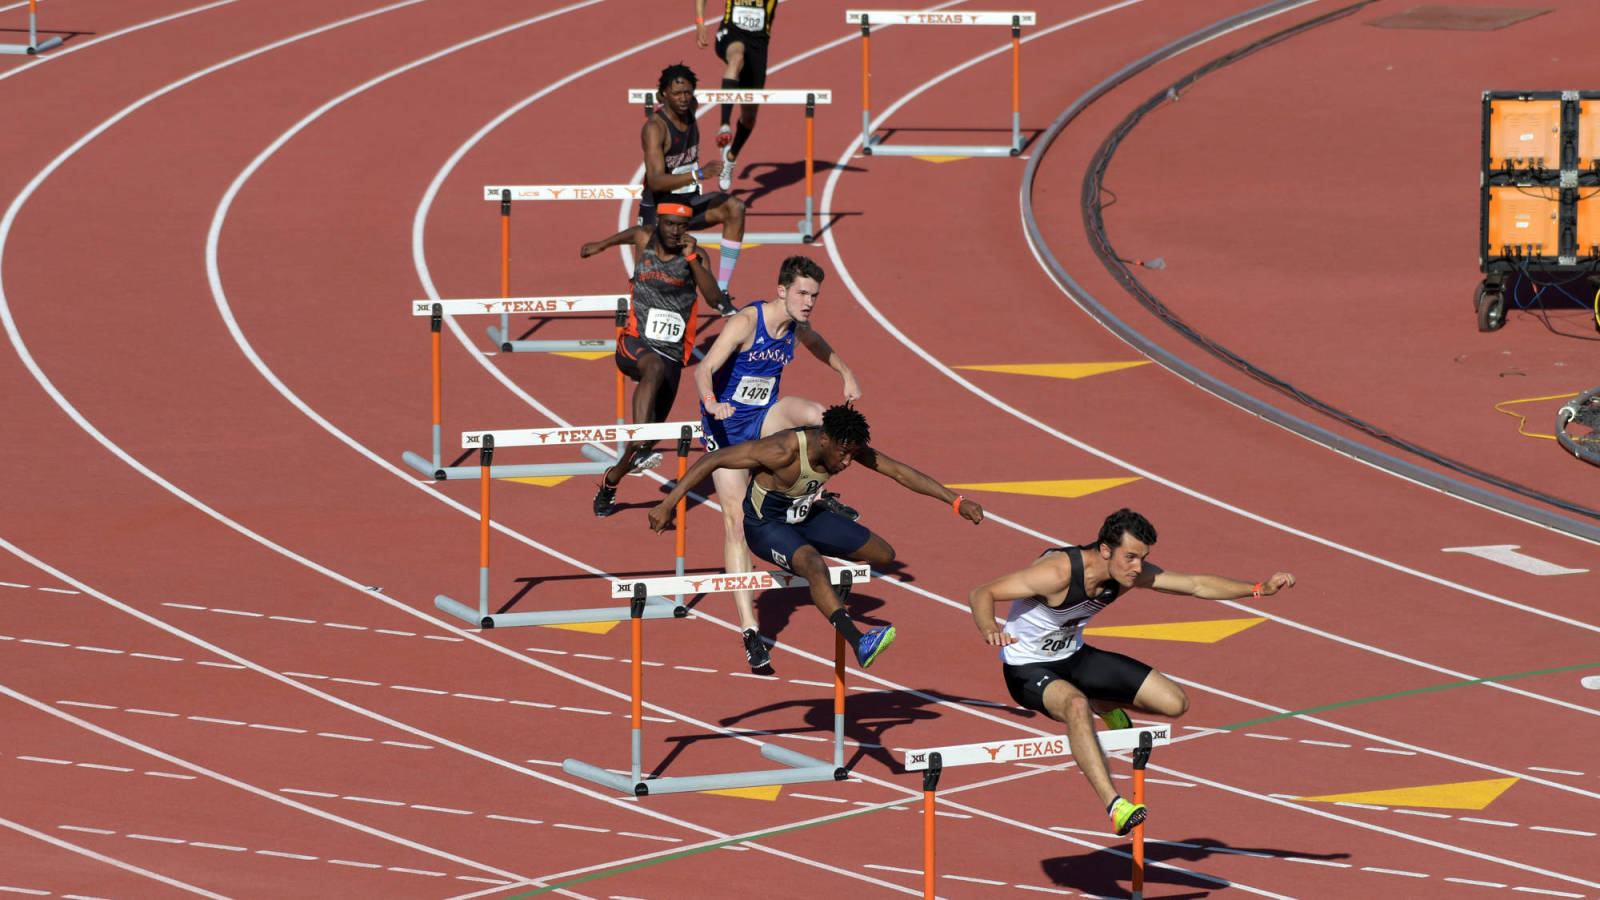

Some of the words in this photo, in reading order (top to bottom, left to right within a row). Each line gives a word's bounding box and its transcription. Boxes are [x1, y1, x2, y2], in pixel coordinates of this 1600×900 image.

[917, 14, 963, 24] TEXAS
[706, 93, 754, 102] TEXAS
[573, 188, 615, 199] TEXAS
[502, 300, 557, 313] TEXAS
[652, 320, 681, 337] 1715
[741, 386, 769, 400] 1476
[466, 436, 481, 444] XII
[558, 428, 617, 443] TEXAS
[617, 583, 631, 592] XII
[711, 574, 774, 591] TEXAS
[853, 568, 867, 578] XII
[911, 753, 926, 763] XII
[1013, 739, 1064, 758] TEXAS
[1153, 729, 1167, 739] XII
